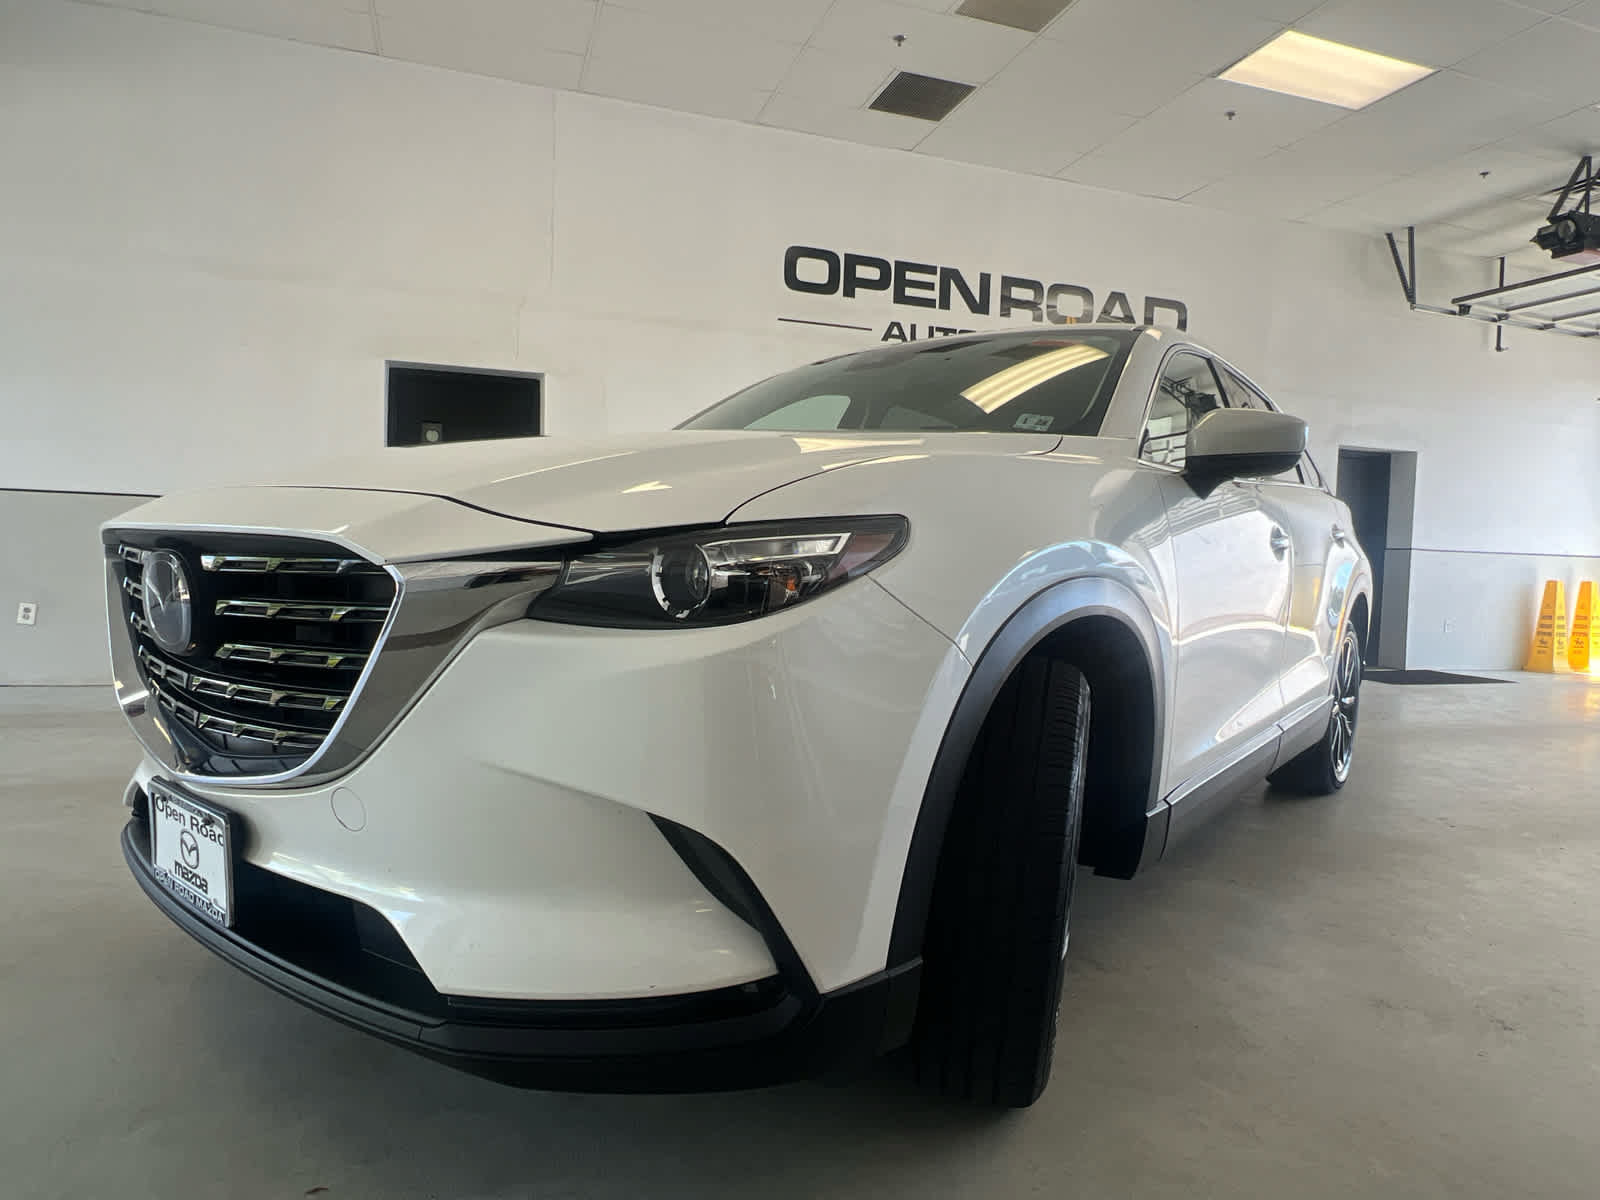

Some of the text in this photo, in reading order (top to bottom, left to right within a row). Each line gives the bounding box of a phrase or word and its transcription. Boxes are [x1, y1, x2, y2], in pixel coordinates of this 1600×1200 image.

[784, 245, 1188, 332] OPEN ROAD
[881, 321, 977, 343] AUT
[155, 796, 186, 826] Open
